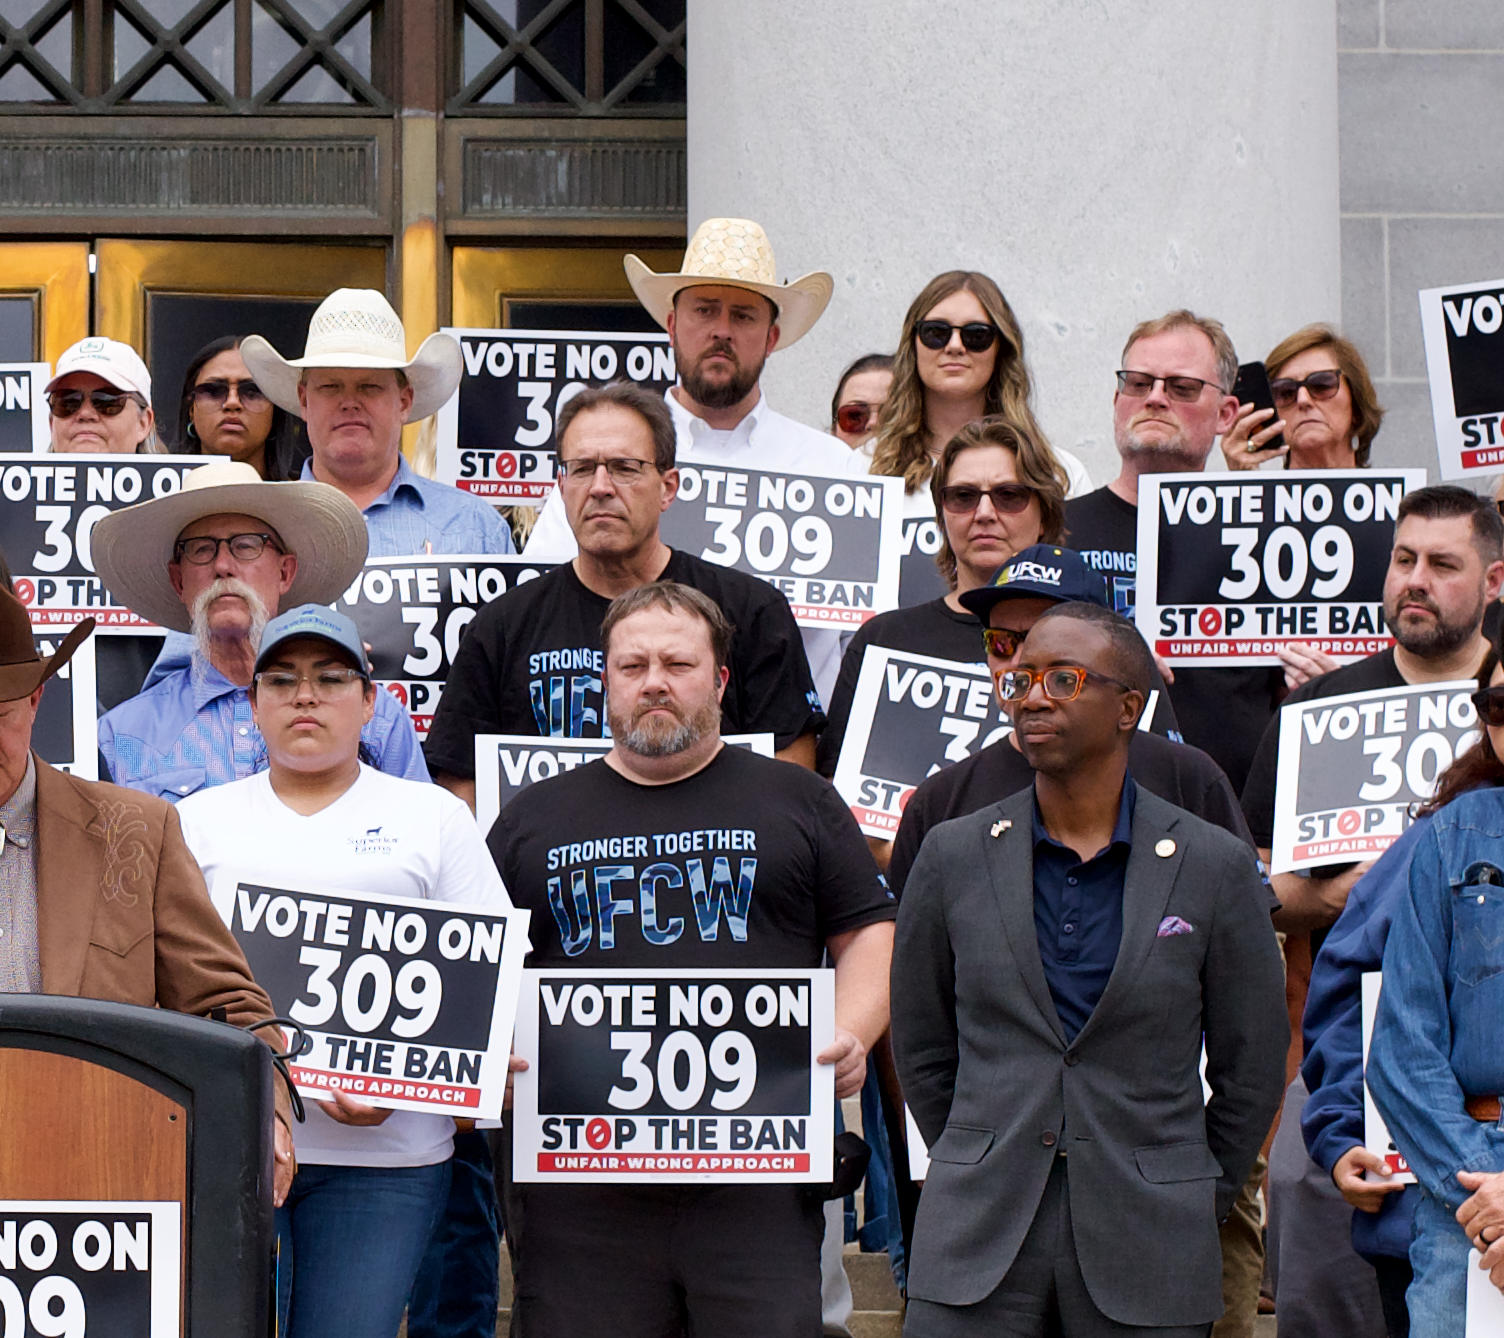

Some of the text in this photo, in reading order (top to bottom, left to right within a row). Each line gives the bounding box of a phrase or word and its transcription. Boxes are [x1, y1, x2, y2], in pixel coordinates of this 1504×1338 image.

[461, 341, 617, 379] VOTE NO
[759, 477, 881, 518] NO ON
[1160, 483, 1401, 524] VOTE NO ON
[701, 506, 833, 574] 309
[1008, 561, 1062, 581] UFCW
[1219, 526, 1353, 599] 309
[1255, 606, 1318, 635] THE
[529, 647, 604, 675] STRONGE
[1302, 699, 1408, 743] VOTE
[547, 829, 757, 871] STRONGER TOGETHER
[547, 856, 758, 957] UFCW
[237, 892, 503, 964] VOTE NO ON
[289, 946, 442, 1038] 309
[540, 984, 808, 1027] VOTE NO ON
[326, 1036, 481, 1085] THE BAN
[608, 1031, 756, 1110] 309
[367, 1081, 465, 1103] APPROACH
[648, 1118, 717, 1150] THE
[730, 1119, 805, 1150] BAN
[696, 1157, 794, 1169] APPROACH
[73, 1221, 148, 1271] ON
